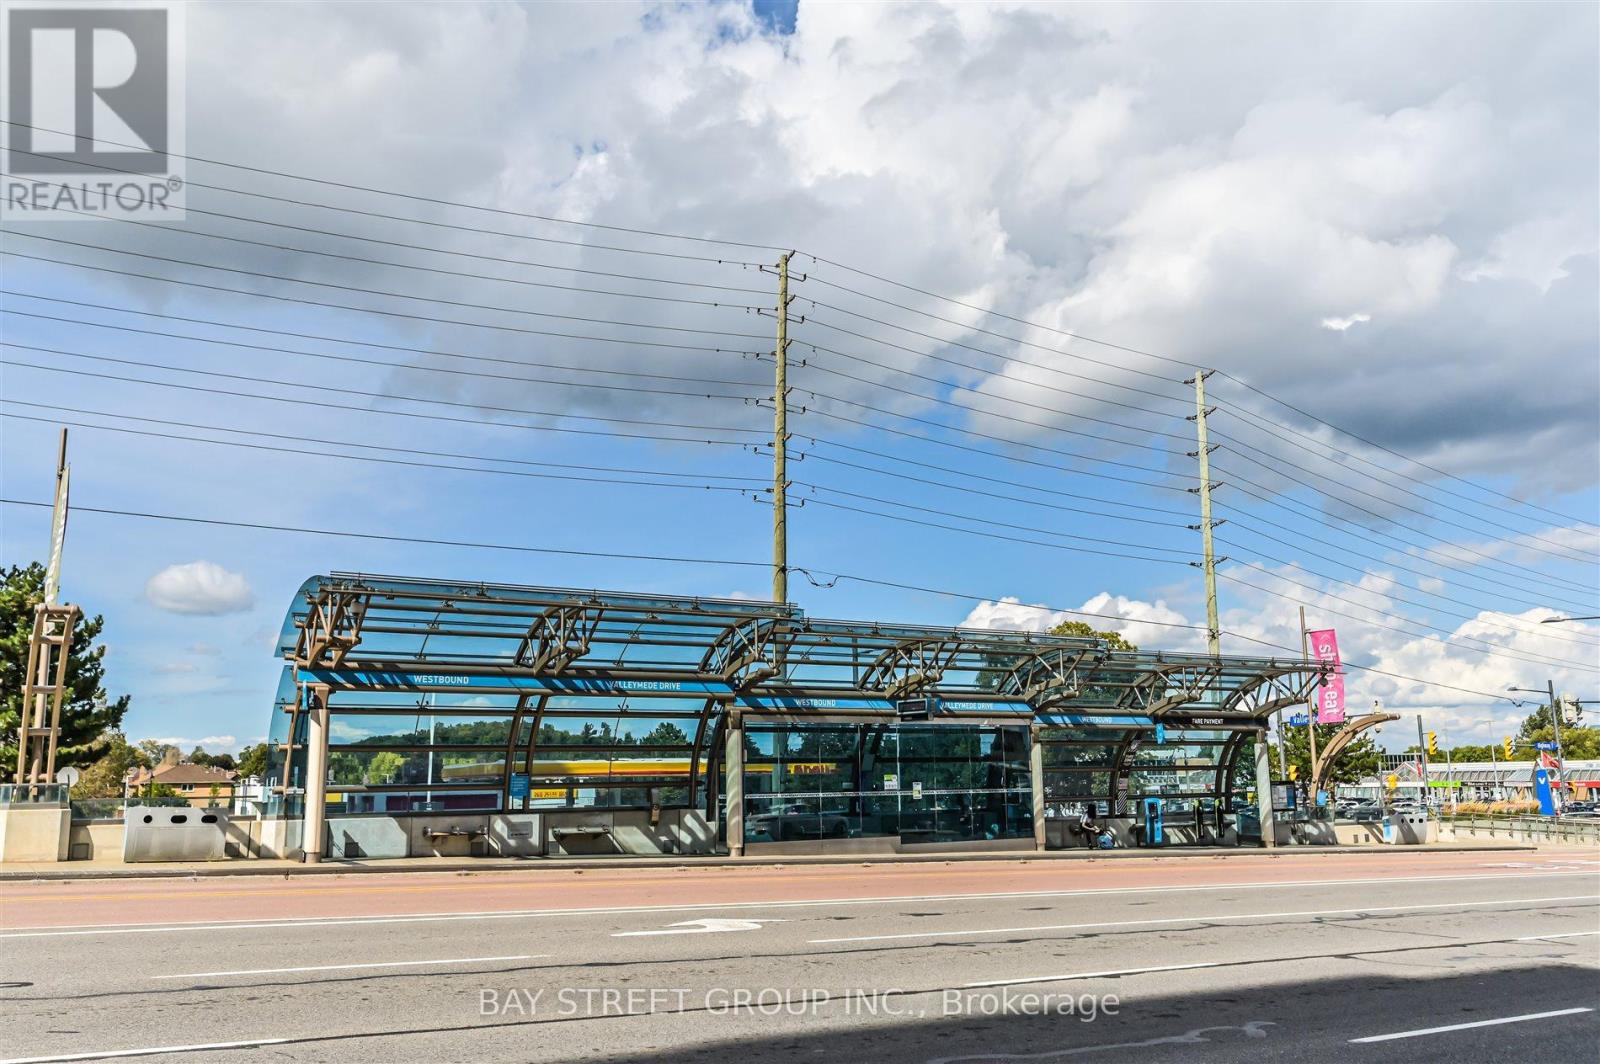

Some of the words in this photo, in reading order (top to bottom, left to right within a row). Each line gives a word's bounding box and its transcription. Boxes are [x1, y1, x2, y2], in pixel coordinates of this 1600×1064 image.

[414, 675, 470, 684] WESTBOUND
[1319, 644, 1340, 715] shp+eat
[608, 680, 658, 690] VALLEYMEDE
[659, 682, 681, 690] DRIVE
[795, 699, 836, 708] WESTBOUND
[940, 701, 977, 710] VALLEYMEDE
[977, 702, 994, 710] DRIVE
